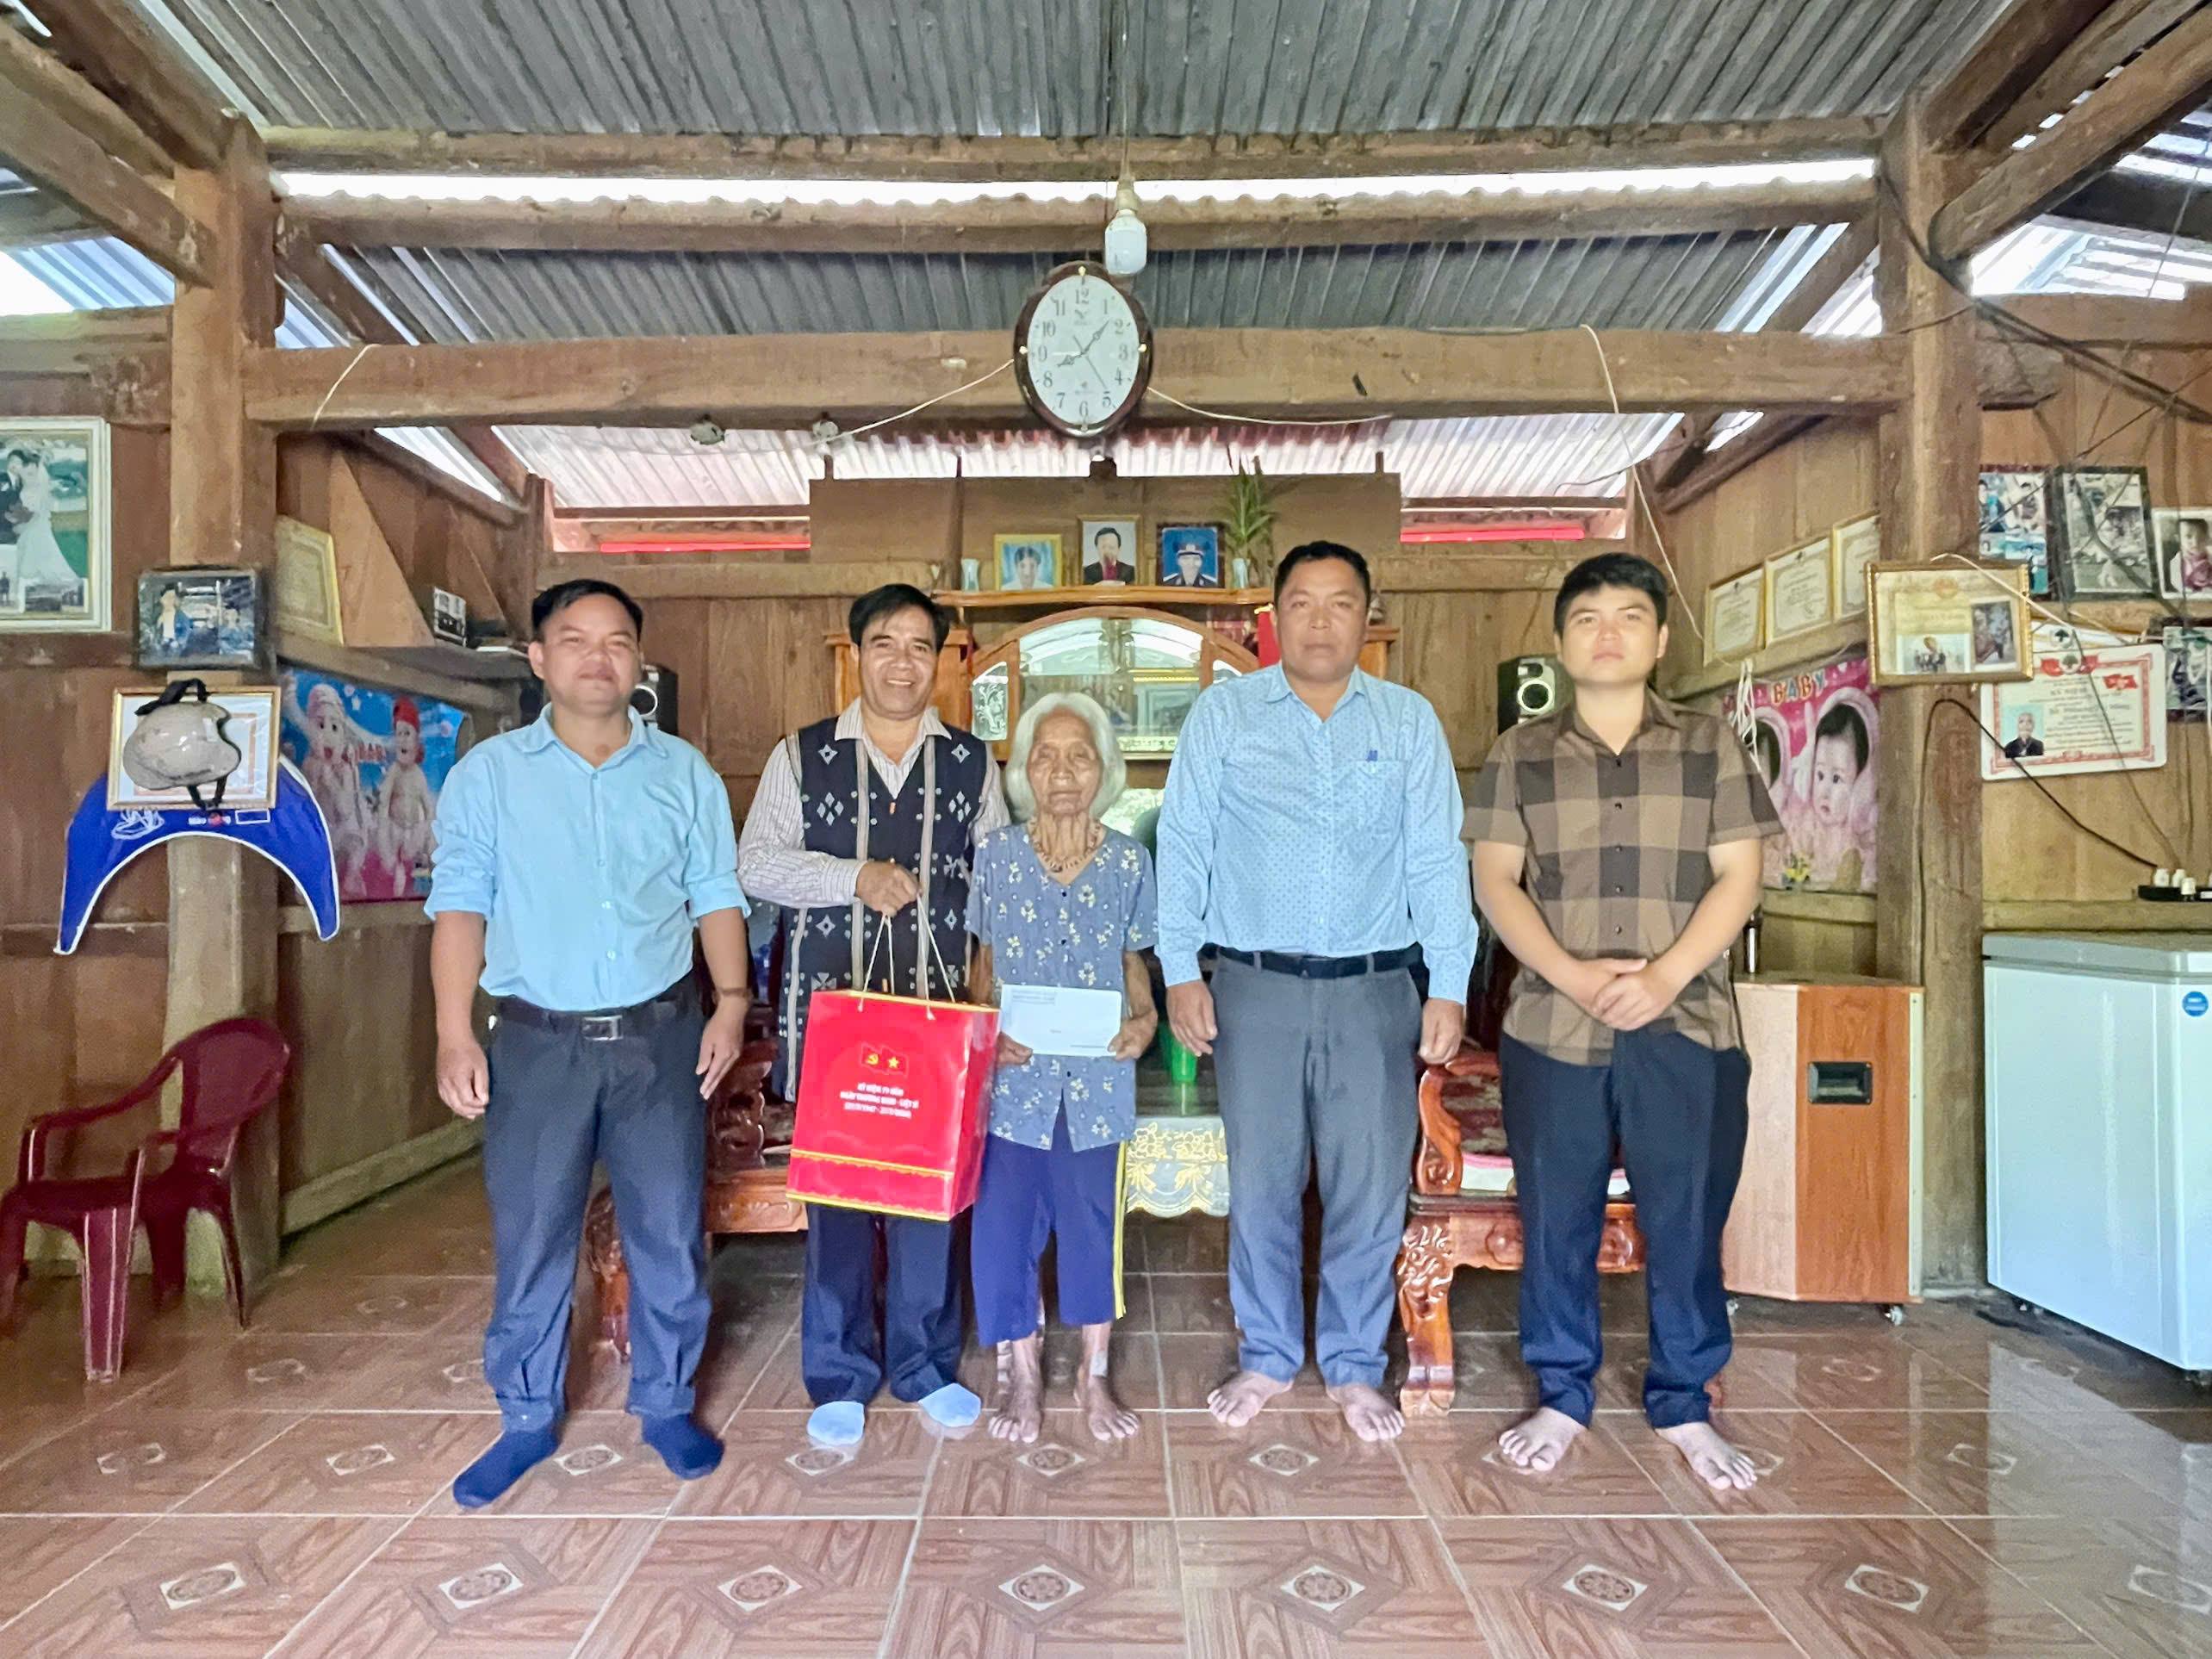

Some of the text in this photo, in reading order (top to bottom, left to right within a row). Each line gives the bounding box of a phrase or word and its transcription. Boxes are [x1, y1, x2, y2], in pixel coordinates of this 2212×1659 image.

[1074, 289, 1090, 304] 12
[1054, 299, 1066, 316] 11
[1103, 298, 1108, 315] 1
[1042, 320, 1056, 338] 10
[1115, 319, 1124, 335] 2
[1119, 345, 1128, 360] 3
[1042, 370, 1053, 388] 8
[1115, 367, 1123, 385] 4
[1056, 392, 1066, 409] 7
[1102, 390, 1112, 407] 5
[1078, 401, 1089, 418] 6
[1770, 668, 1825, 706] BABY
